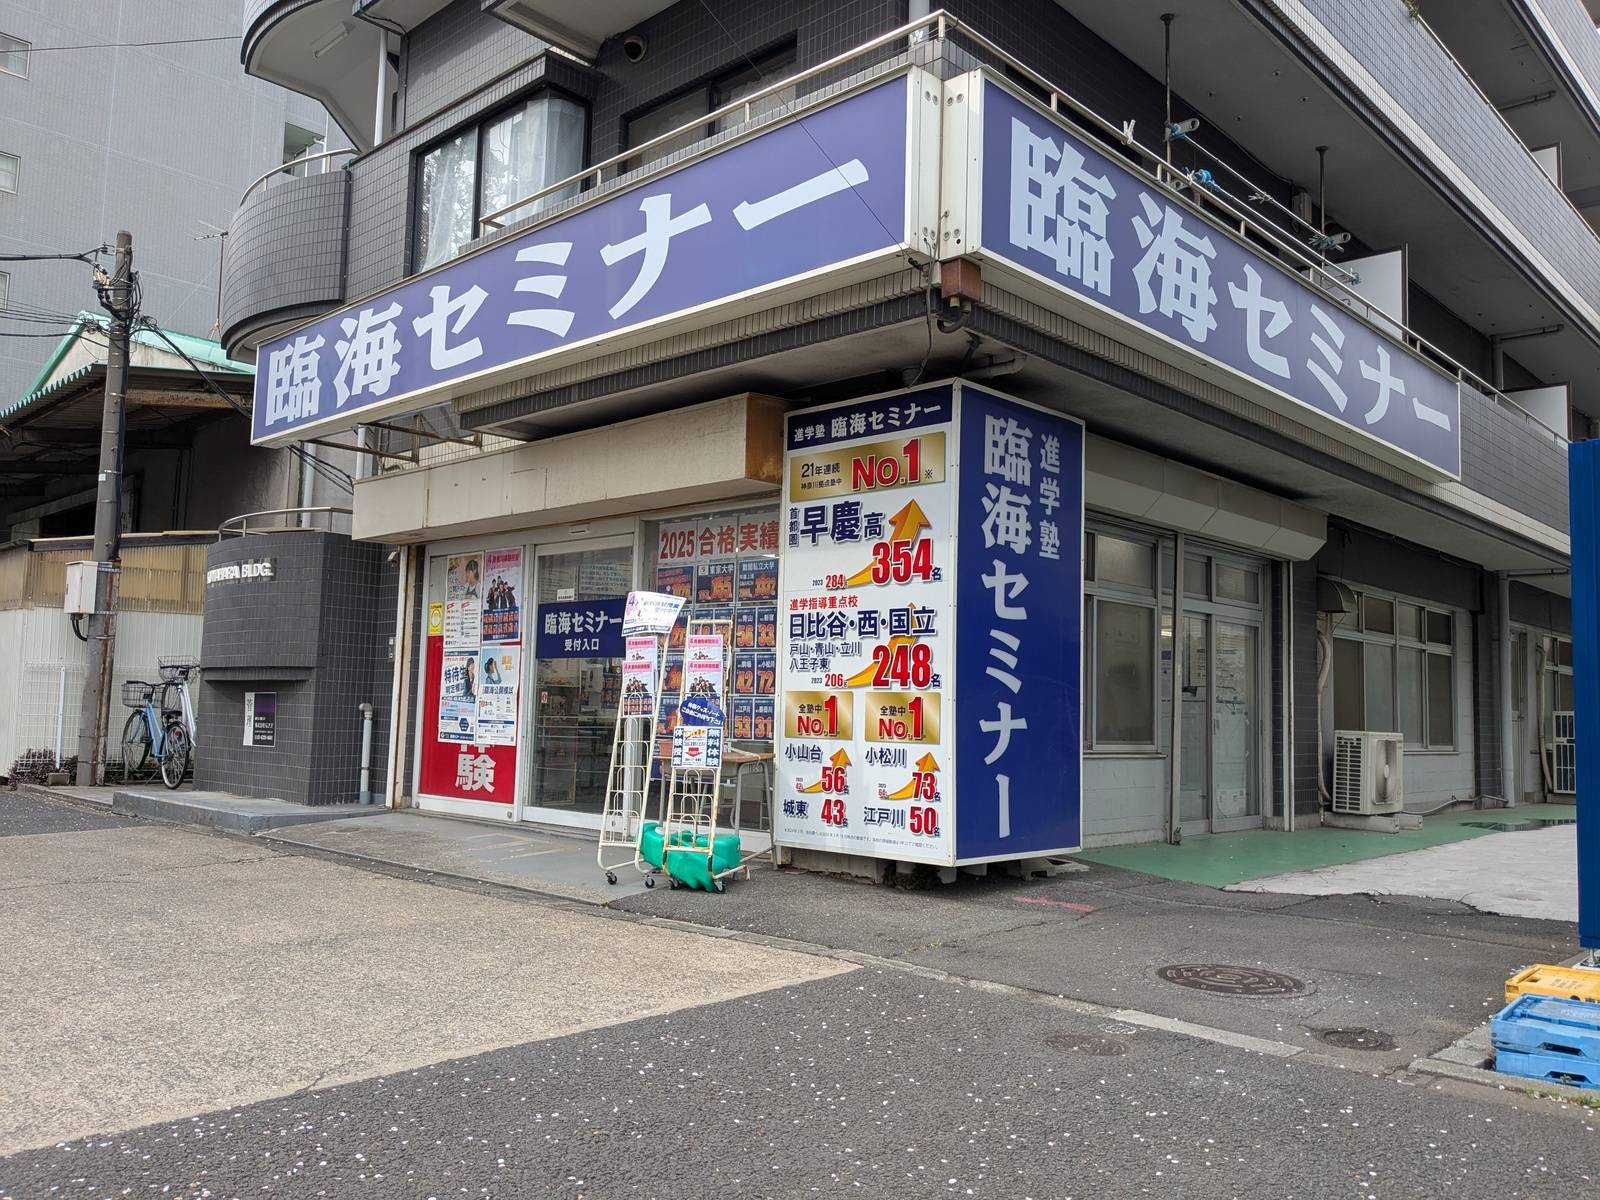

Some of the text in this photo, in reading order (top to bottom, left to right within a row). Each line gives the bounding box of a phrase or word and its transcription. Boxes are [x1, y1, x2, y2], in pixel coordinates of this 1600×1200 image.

[1009, 116, 1452, 431] 臨海セミナー
[265, 158, 871, 427] 臨海セミナー
[794, 403, 942, 442] 進学塾 臨海セミナー
[801, 462, 841, 478] 21年連続
[1039, 433, 1061, 560] 進学塾
[789, 507, 799, 547] 首都圏
[790, 595, 858, 611] 進学指導重点校
[544, 610, 622, 635] 臨海セミナー
[789, 606, 936, 639] 日比谷・西・国立
[979, 414, 1033, 838] 臨海セミナー
[564, 638, 599, 651] 受付入口
[789, 642, 862, 656] 戸山・青山・立川
[789, 658, 830, 671] 八王子東
[798, 703, 823, 714] 全塾中
[880, 705, 906, 717] 全塾中
[785, 743, 822, 762] 小山台
[865, 747, 906, 766] 小松川
[783, 799, 808, 816] 城東
[864, 806, 905, 827] 江戸川
